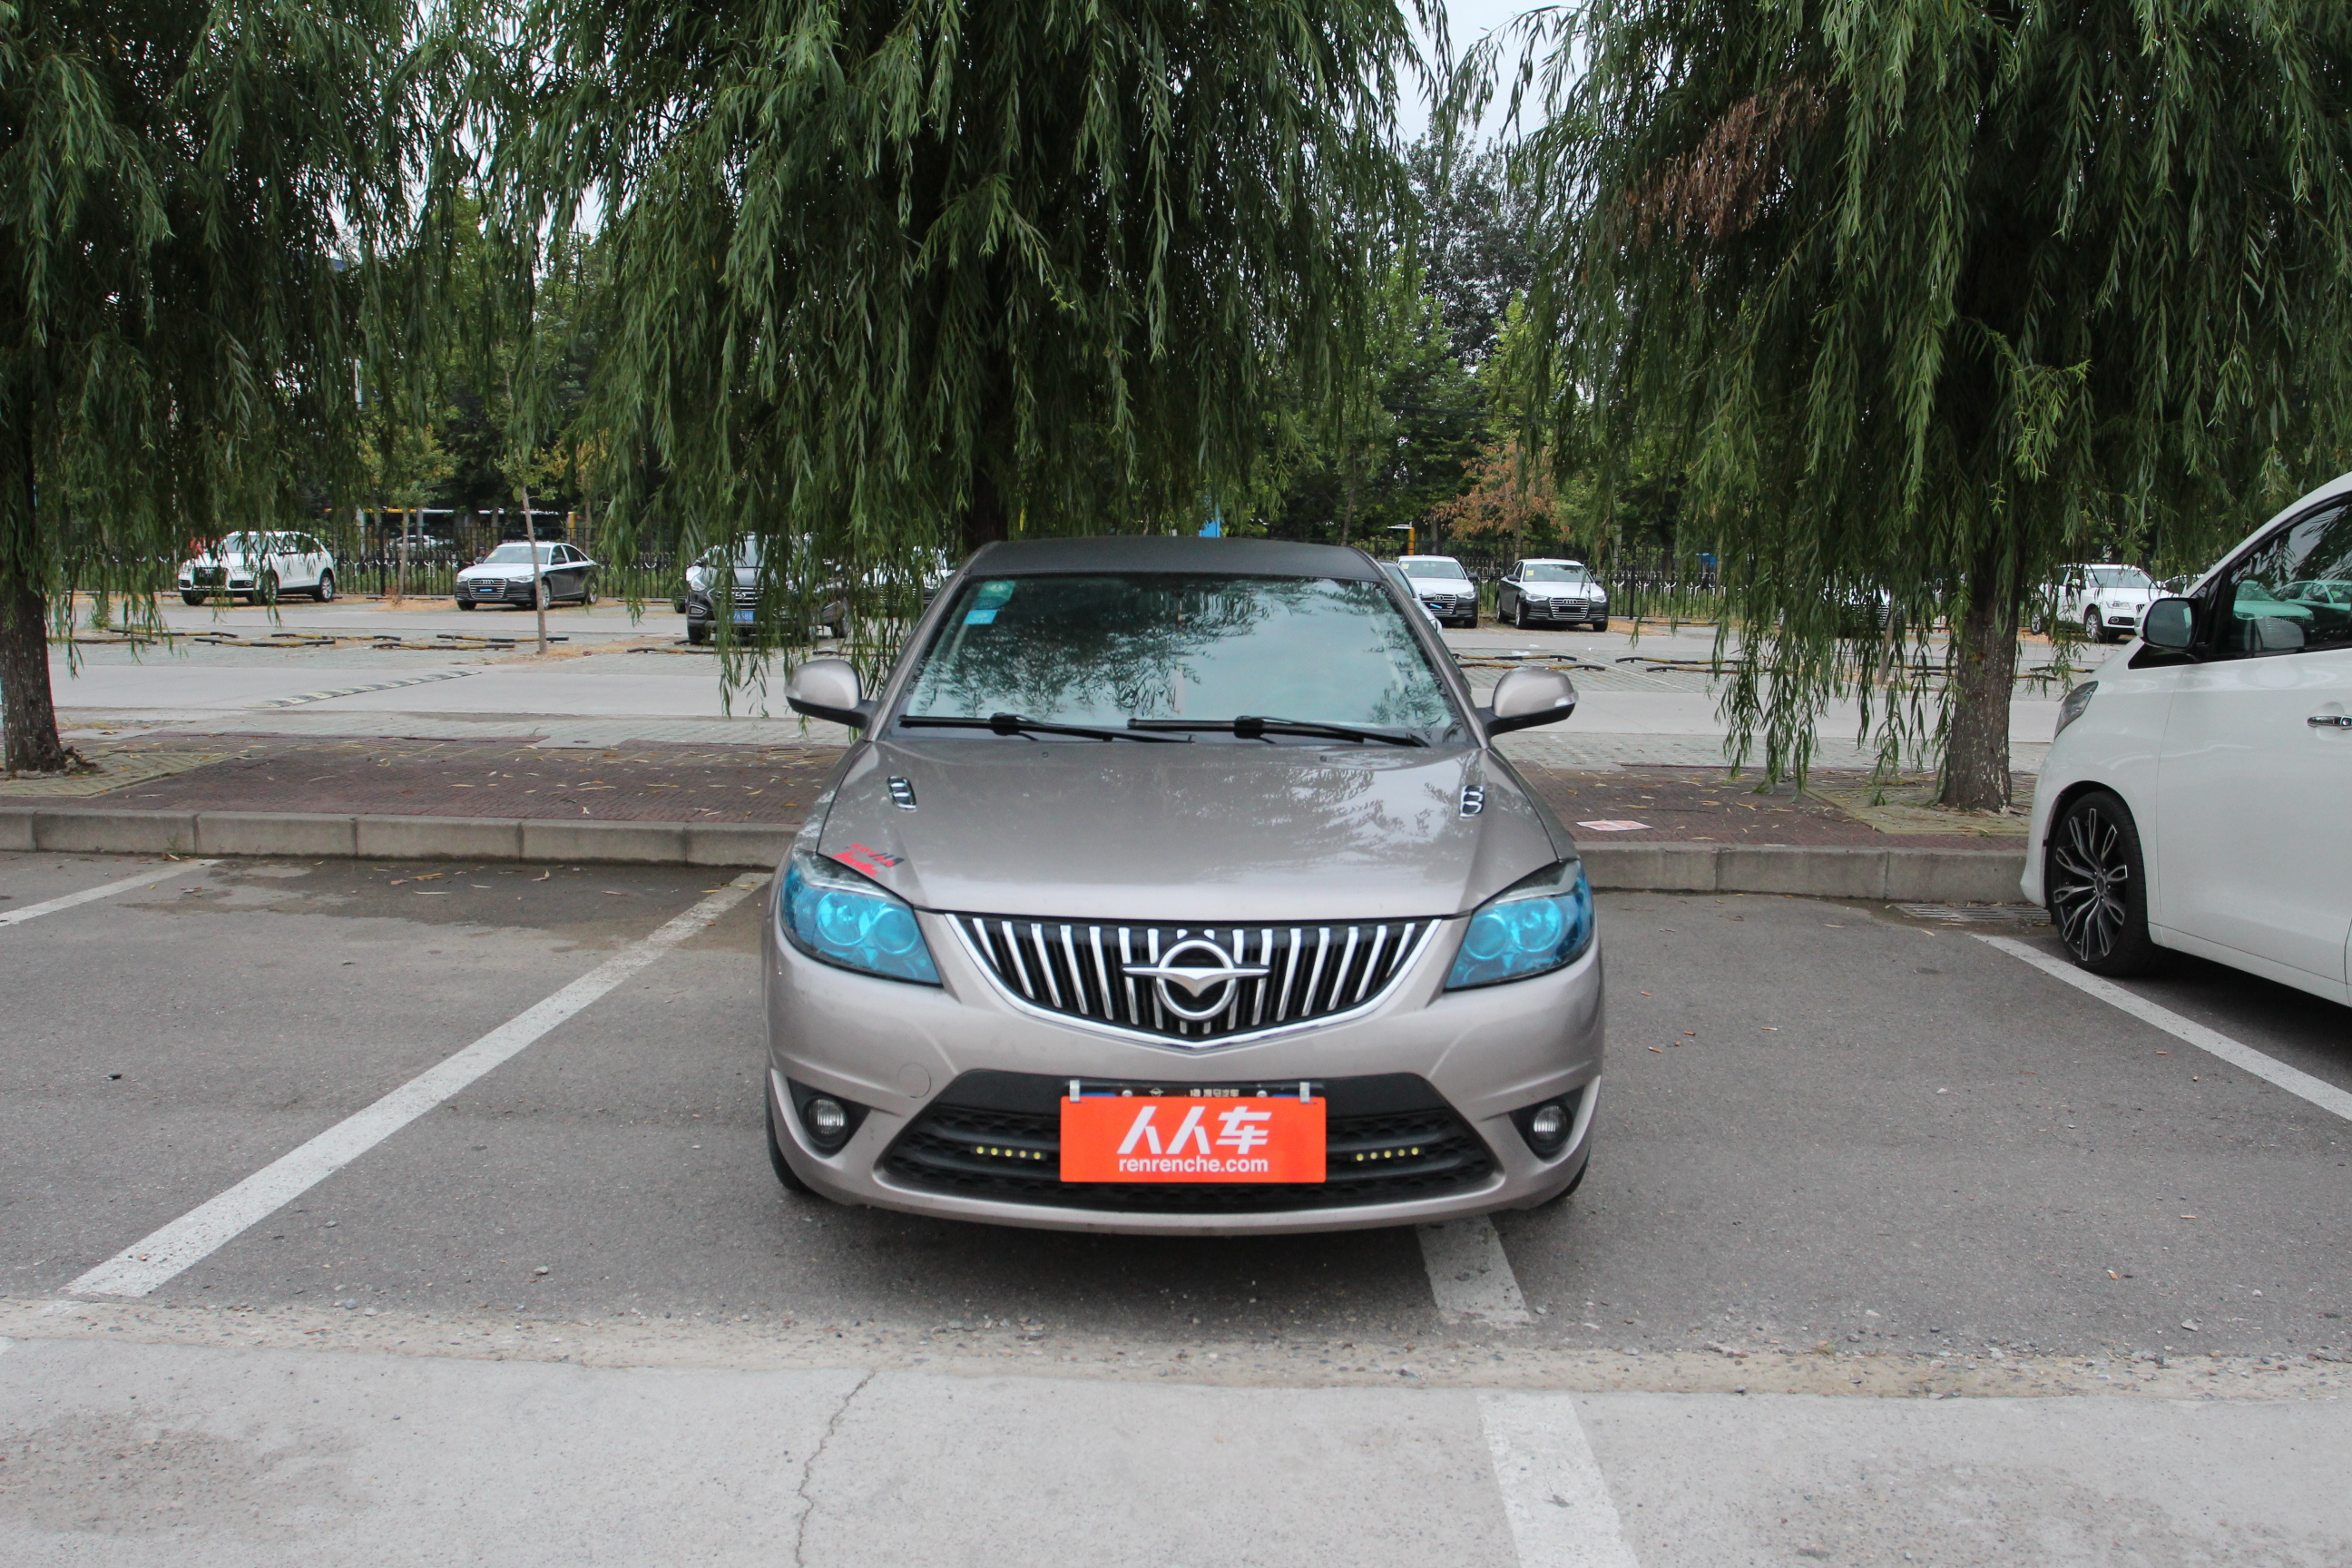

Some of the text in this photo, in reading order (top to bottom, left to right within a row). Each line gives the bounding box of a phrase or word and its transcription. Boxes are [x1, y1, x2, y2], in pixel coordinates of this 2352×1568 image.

[1116, 1105, 1272, 1154] 人人车
[1119, 1155, 1269, 1172] renrenche.com
